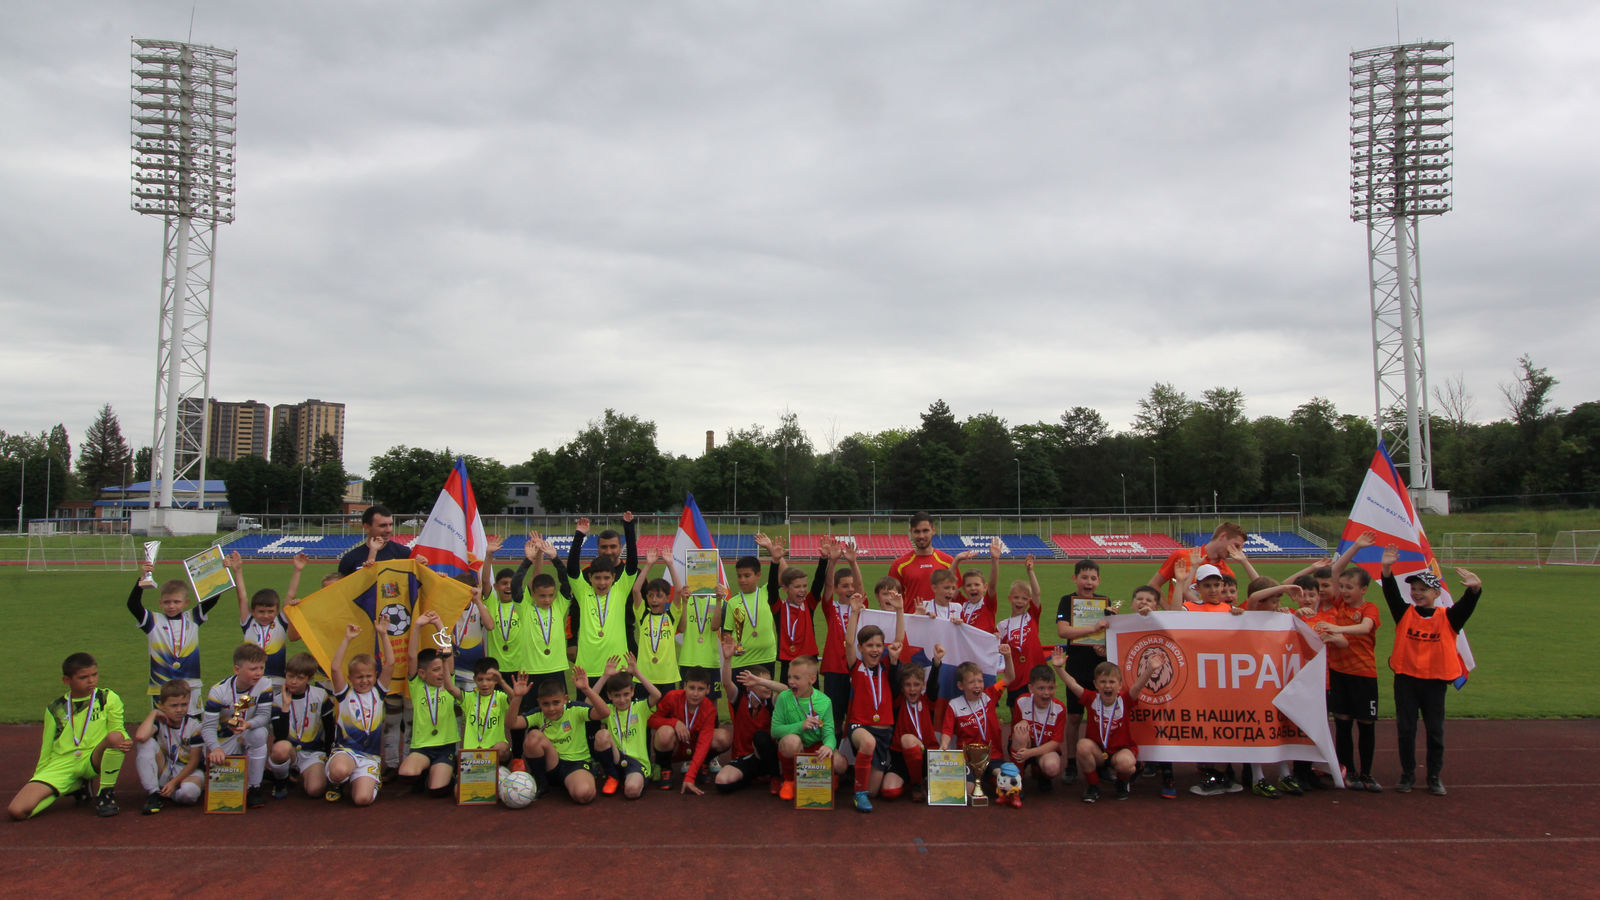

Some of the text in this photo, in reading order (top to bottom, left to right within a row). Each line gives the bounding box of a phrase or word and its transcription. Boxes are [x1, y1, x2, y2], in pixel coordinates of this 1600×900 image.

[1126, 638, 1185, 671] ФУТБОЛЬНАЯ ШКОЛА
[1197, 643, 1302, 689] ПРАЙ
[1140, 694, 1172, 704] ПРАЙД
[1370, 701, 1376, 716] 5
[1181, 709, 1191, 722] В
[1196, 709, 1261, 725] НАШИХ,
[1265, 710, 1274, 722] В
[1154, 725, 1308, 742] ЖДЕМ, КОГДА ЗАБЬЕ
